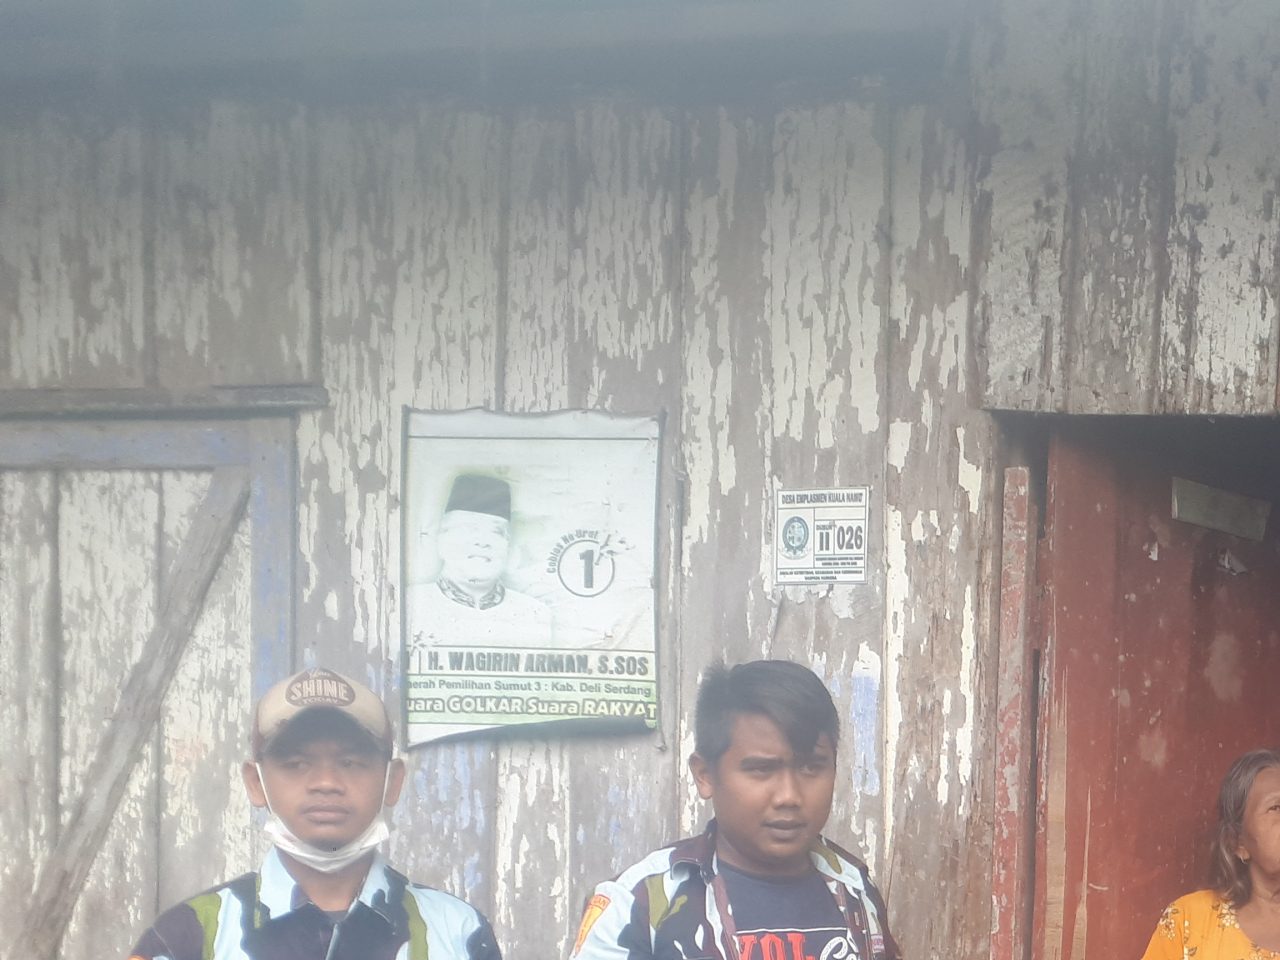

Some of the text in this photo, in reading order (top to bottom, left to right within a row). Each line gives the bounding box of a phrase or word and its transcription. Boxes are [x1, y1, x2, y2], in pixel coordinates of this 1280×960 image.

[836, 525, 863, 550] 026
[579, 549, 594, 588] 1
[427, 651, 444, 671] H.
[447, 651, 520, 672] WAGIRIN
[523, 653, 593, 676] ARMAN,
[597, 655, 649, 676] S.SOS
[290, 679, 350, 702] SHINE
[438, 679, 492, 690] Pemilihan
[494, 680, 532, 691] Sumut
[534, 681, 542, 691] 3
[551, 681, 577, 692] Kab.
[580, 683, 601, 693] Deli
[604, 684, 652, 698] Serdang
[446, 695, 525, 714] GOLKAR
[526, 697, 579, 716] Suara
[581, 699, 657, 720] RAKYAT
